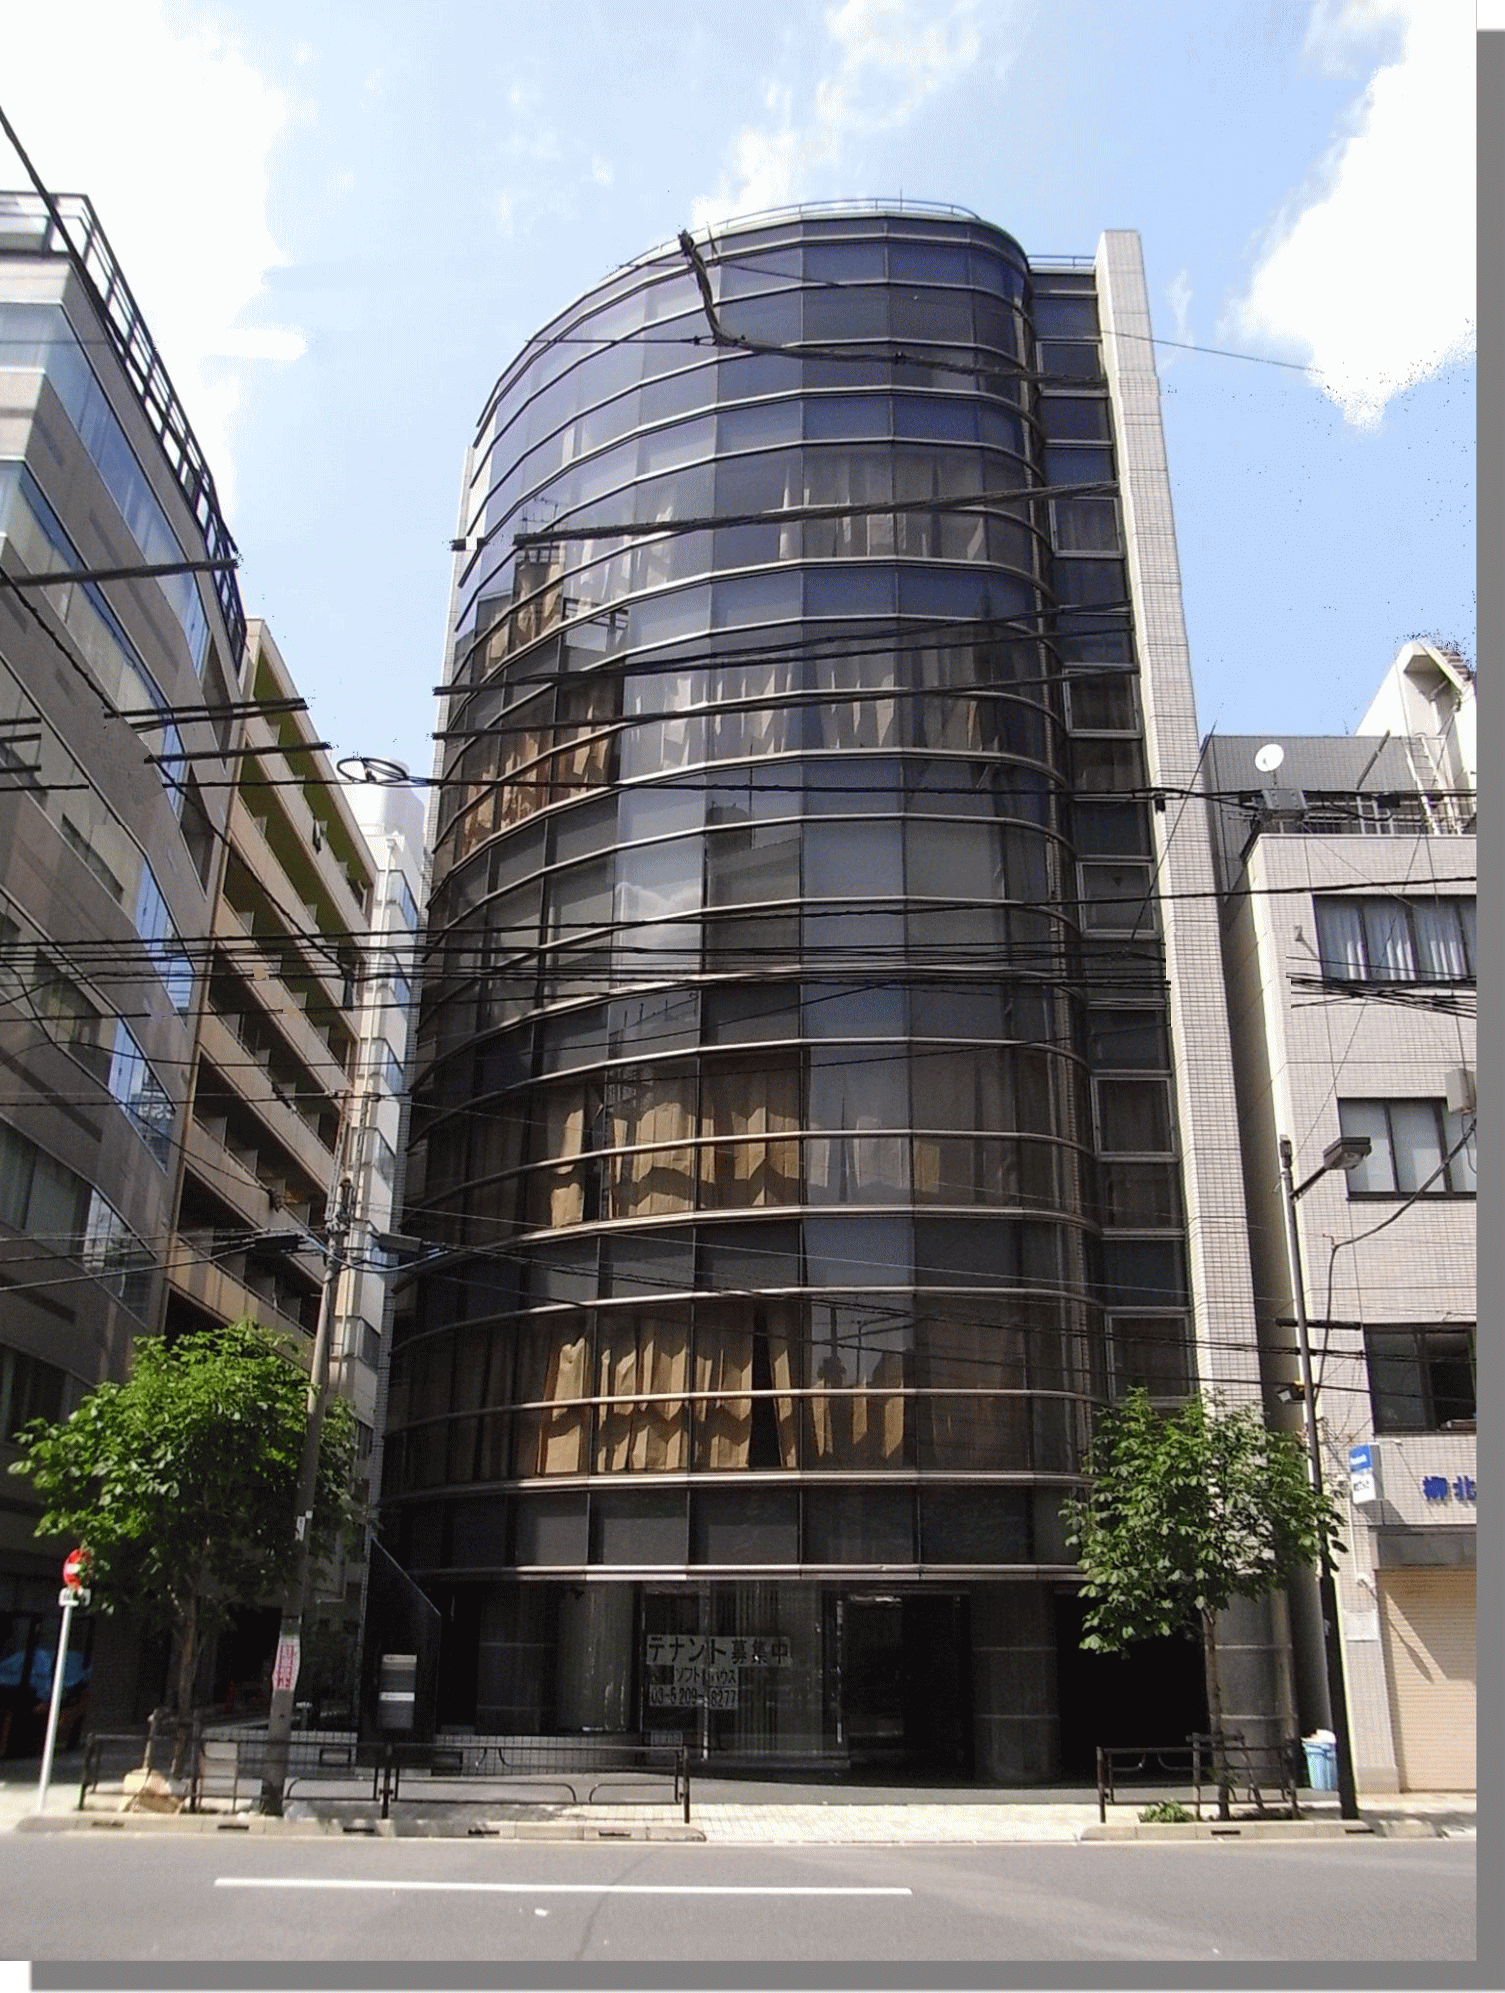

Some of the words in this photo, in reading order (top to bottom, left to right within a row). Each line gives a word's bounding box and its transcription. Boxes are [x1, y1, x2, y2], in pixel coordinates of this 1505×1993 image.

[648, 1637, 788, 1664] テナント募集中
